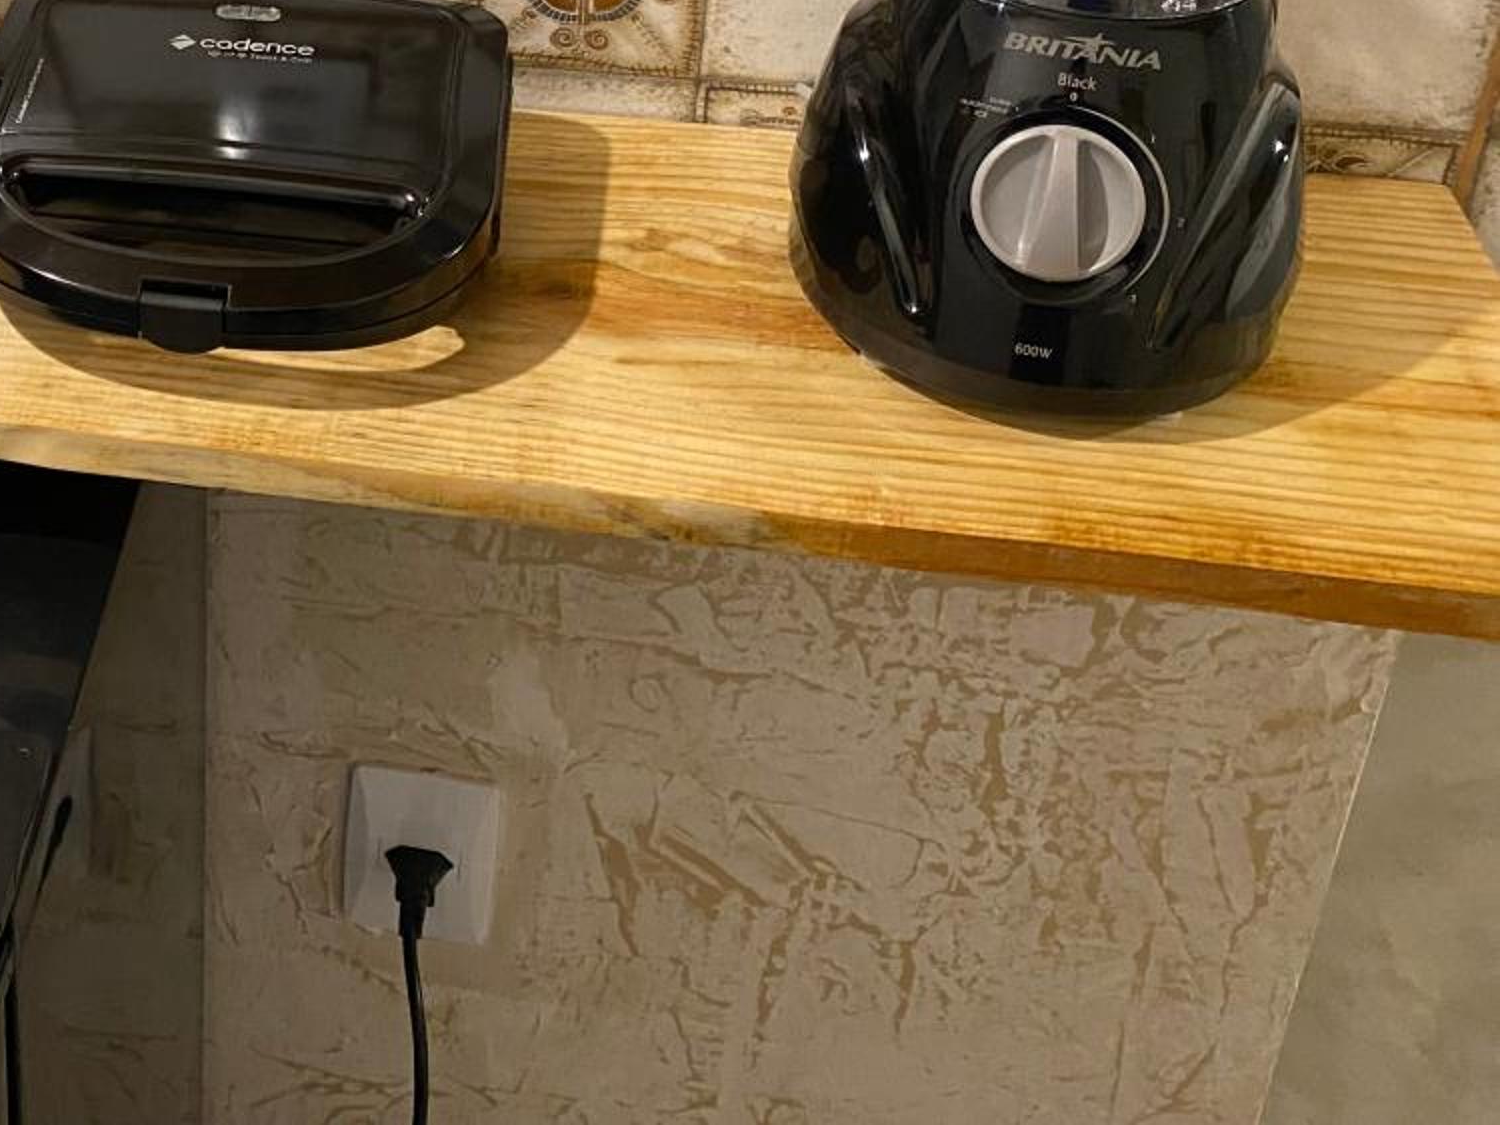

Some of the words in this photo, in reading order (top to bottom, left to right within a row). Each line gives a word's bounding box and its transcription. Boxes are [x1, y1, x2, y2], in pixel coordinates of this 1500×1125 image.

[199, 38, 315, 56] cadence
[1057, 71, 1097, 91] Black
[1014, 342, 1053, 360] 600W
